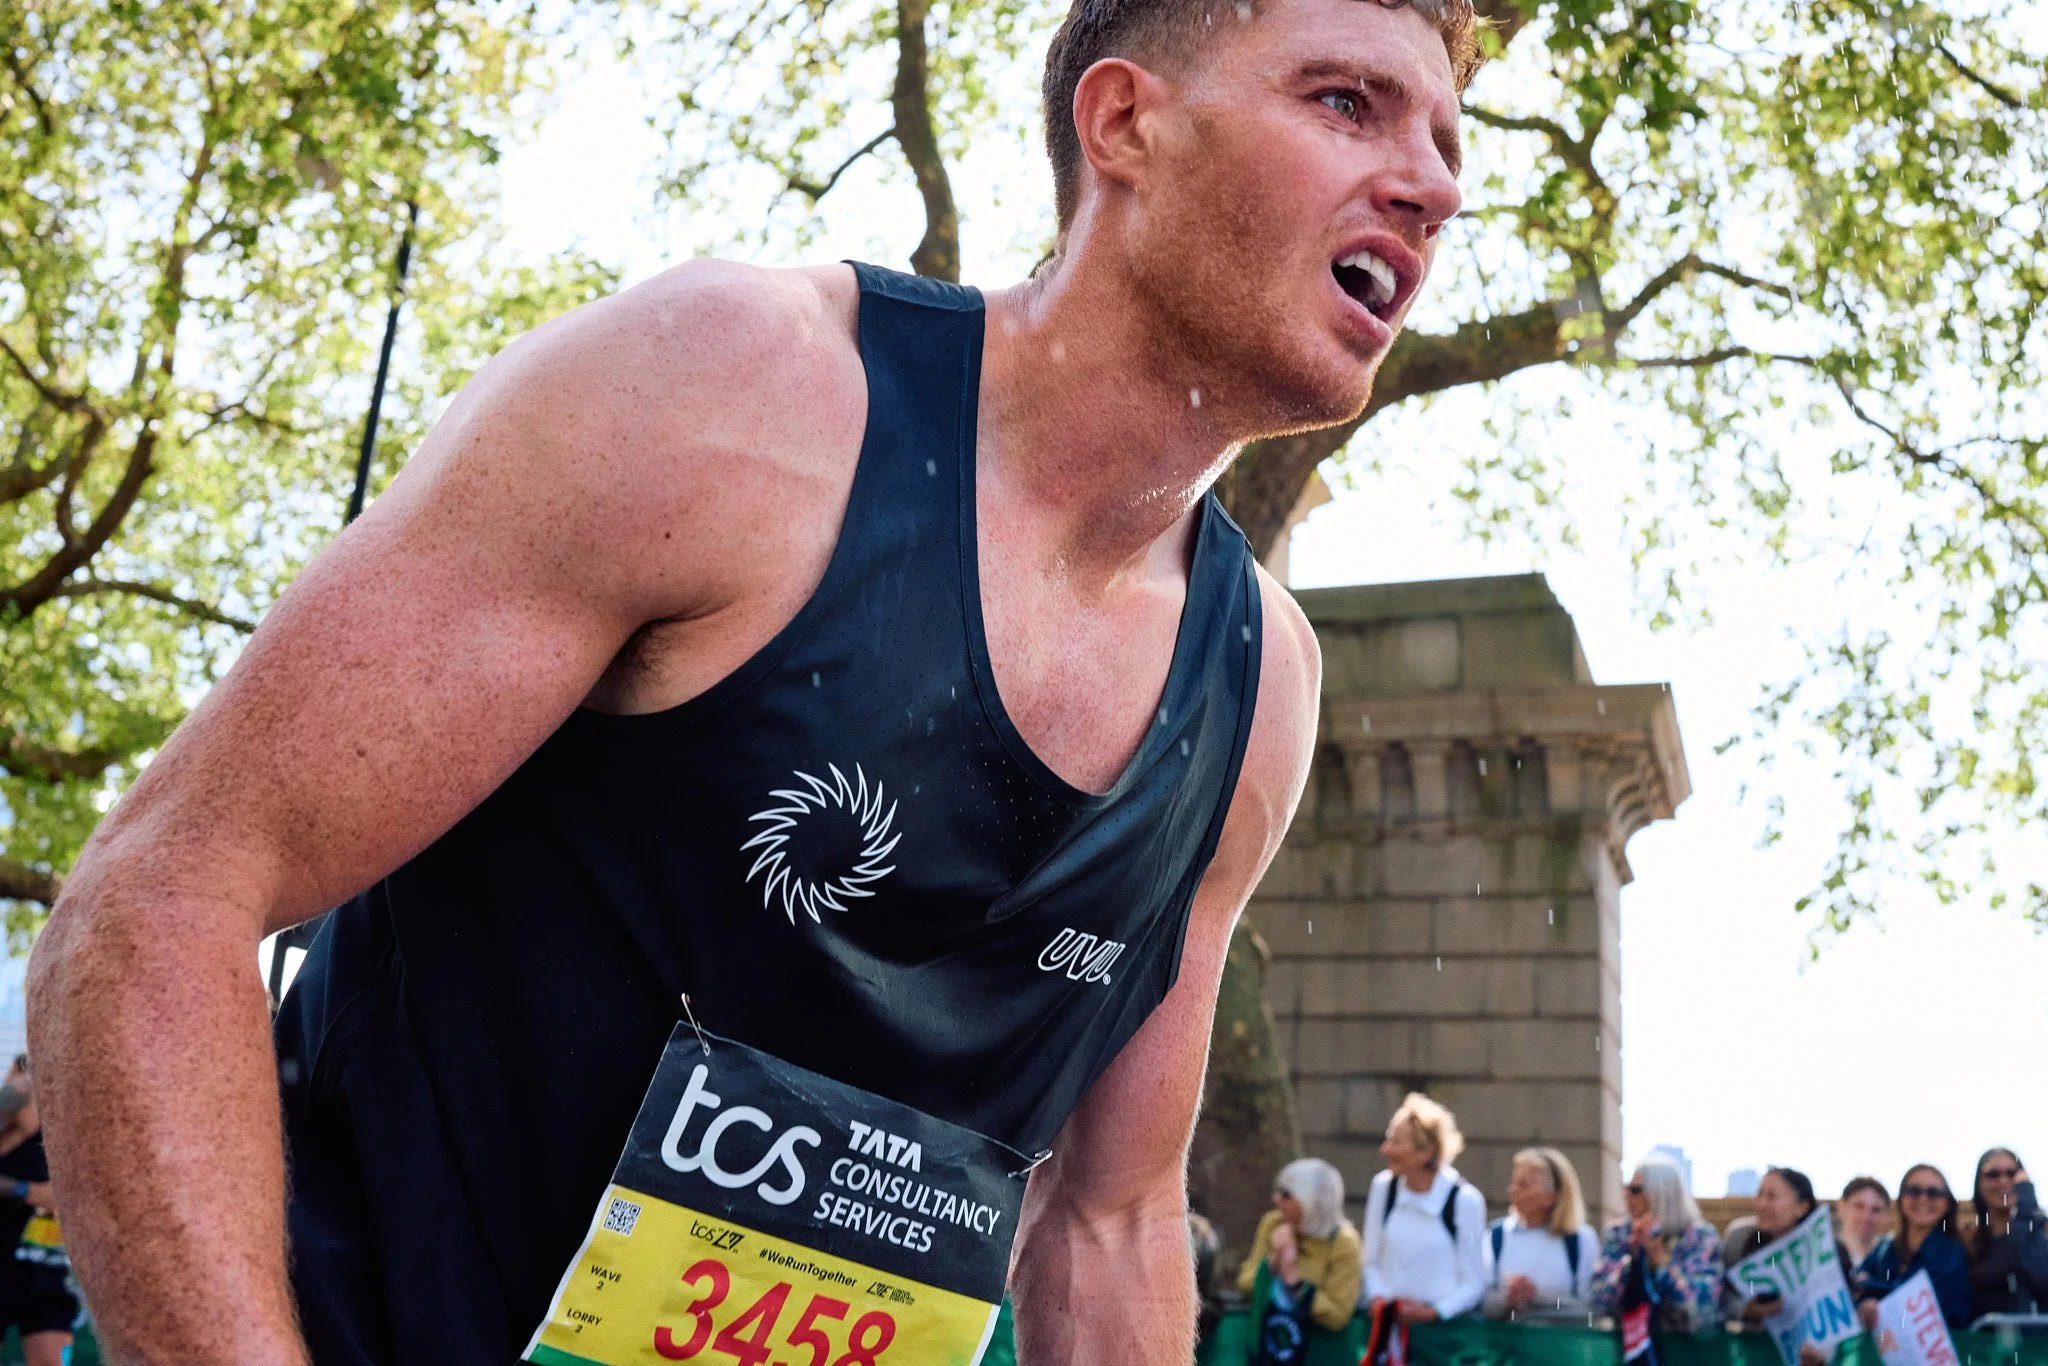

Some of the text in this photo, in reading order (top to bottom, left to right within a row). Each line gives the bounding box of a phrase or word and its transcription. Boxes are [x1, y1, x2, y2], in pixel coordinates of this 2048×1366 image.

[661, 1064, 822, 1206] tcs
[848, 1119, 922, 1173] TATA
[829, 1157, 1001, 1236] CONSULTANCY
[690, 1219, 717, 1242] tcs
[813, 1191, 937, 1254] SERVICES
[590, 1264, 623, 1284] WAVE
[595, 1280, 605, 1291] 2
[758, 1247, 858, 1289] #WeRunTogether
[566, 1307, 603, 1327] LORRY
[574, 1323, 583, 1334] 2
[653, 1258, 897, 1366] 3458
